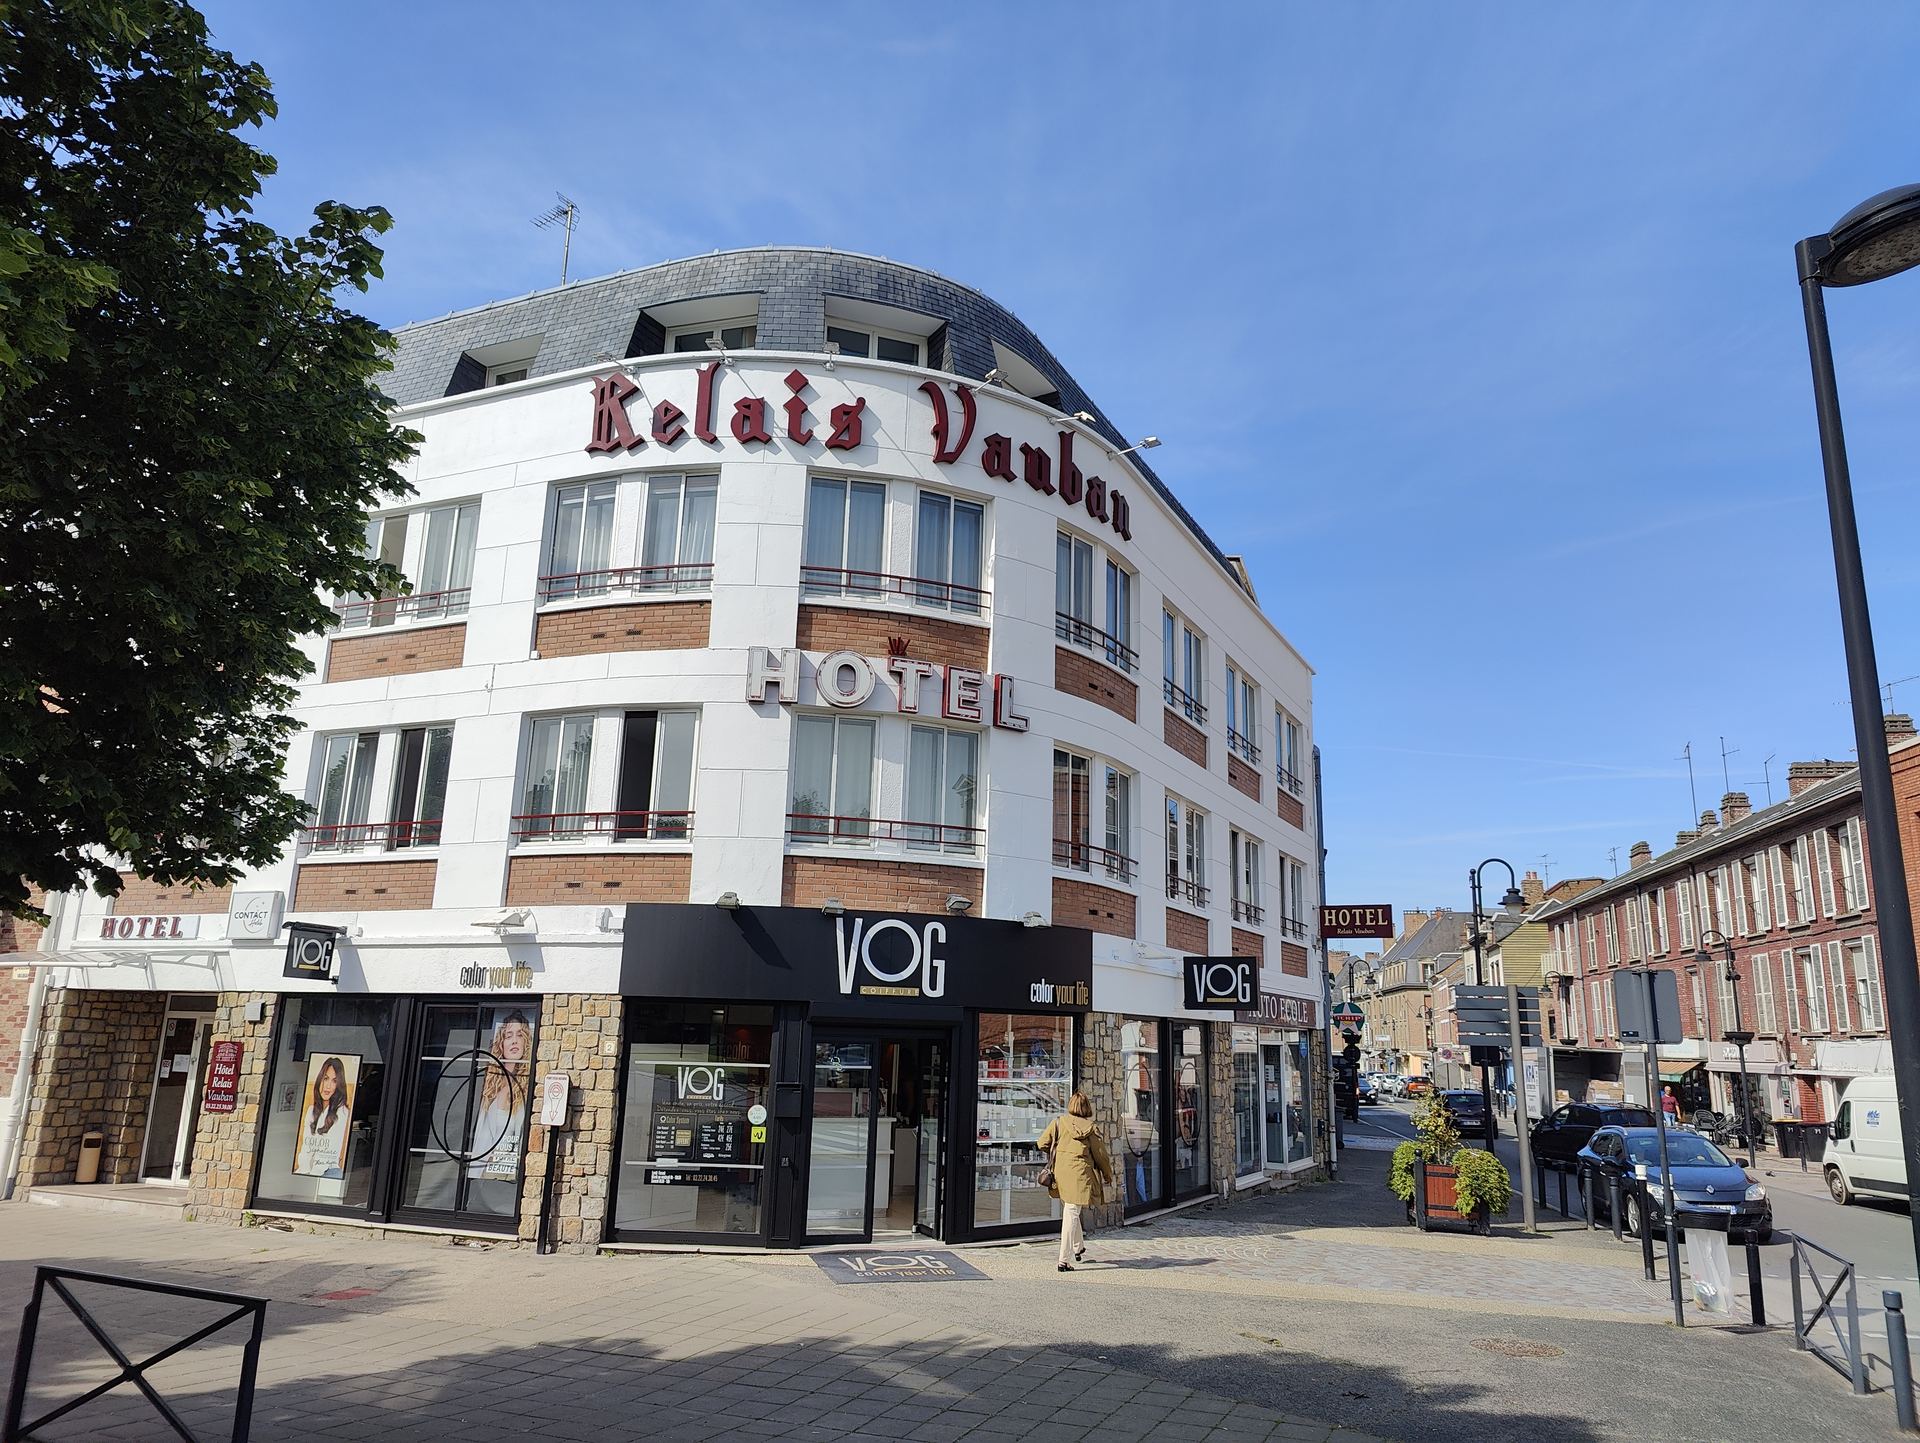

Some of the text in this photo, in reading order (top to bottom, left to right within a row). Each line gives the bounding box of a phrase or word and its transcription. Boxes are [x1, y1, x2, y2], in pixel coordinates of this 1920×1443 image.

[585, 361, 1133, 542] Relais Vauban
[745, 646, 1031, 732] HOTEL
[234, 911, 268, 919] CONTACT
[1323, 908, 1388, 926] HOTEL
[100, 916, 184, 938] HOTEL
[292, 937, 333, 971] VOG
[836, 917, 947, 998] VOG
[860, 987, 919, 996] COIFFURE
[1030, 978, 1089, 1007] color your life
[1193, 963, 1251, 1003] VOG
[1248, 995, 1278, 1019] UTO
[606, 1043, 613, 1051] 2
[214, 1064, 234, 1075] Hôtel
[212, 1077, 233, 1088] Relais
[677, 1066, 725, 1101] VOG
[208, 1089, 234, 1102] Vauban
[838, 1255, 949, 1272] VOG
